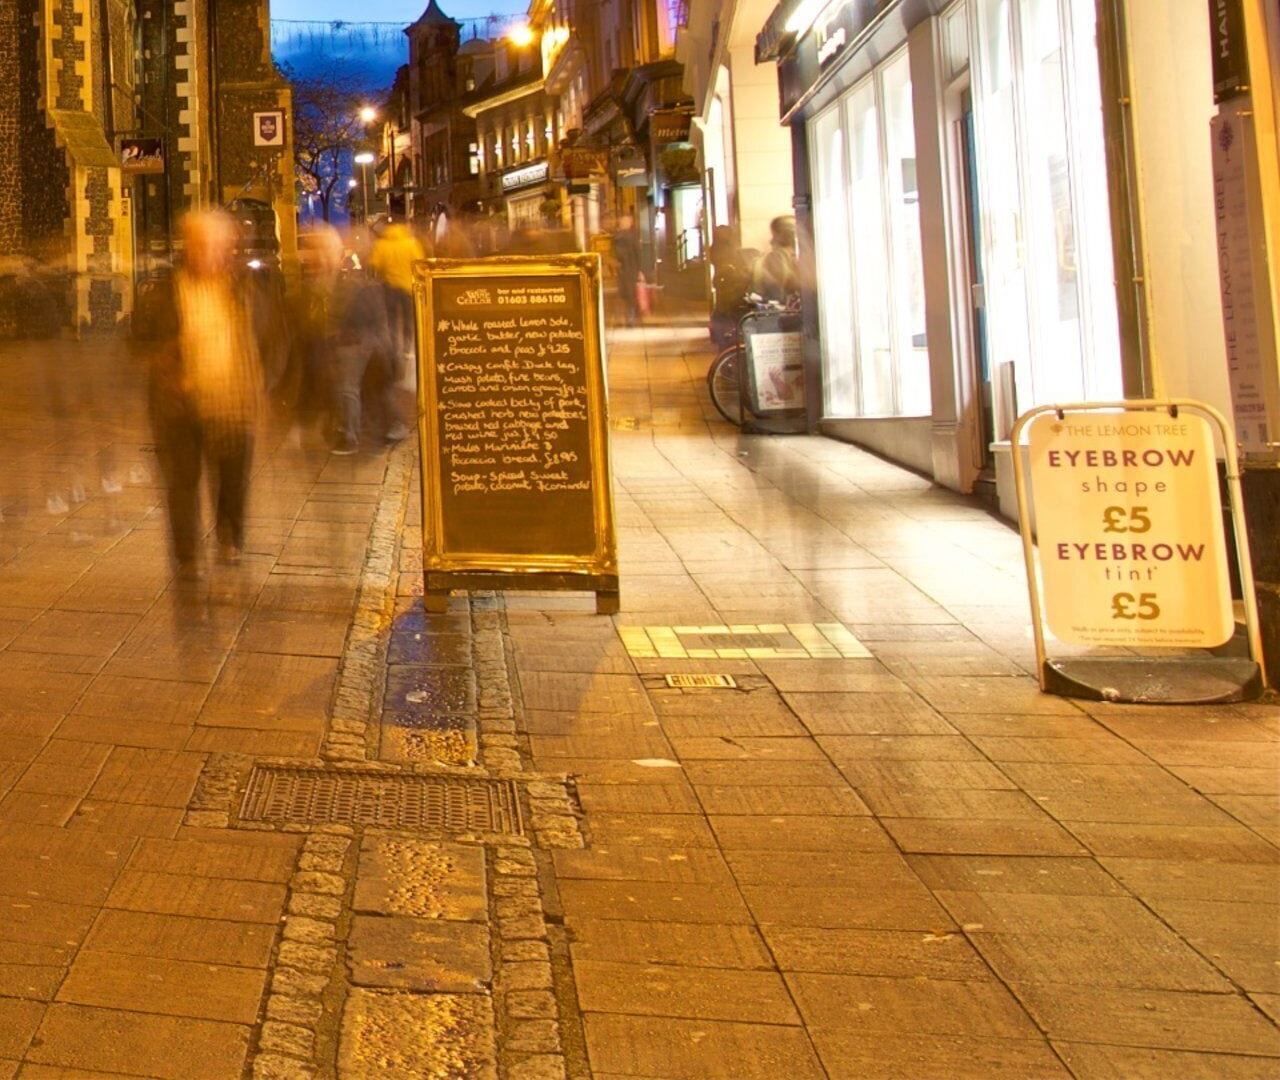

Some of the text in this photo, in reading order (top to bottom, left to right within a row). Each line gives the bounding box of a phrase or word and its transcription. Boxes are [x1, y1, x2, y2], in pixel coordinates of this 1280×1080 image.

[1065, 423, 1188, 437] THE LEMON TREE
[1048, 449, 1196, 468] EYEBROW
[1081, 475, 1168, 498] shape
[1102, 505, 1152, 534] £5
[1057, 542, 1205, 562] EYEBROW
[1111, 592, 1161, 621] £5
